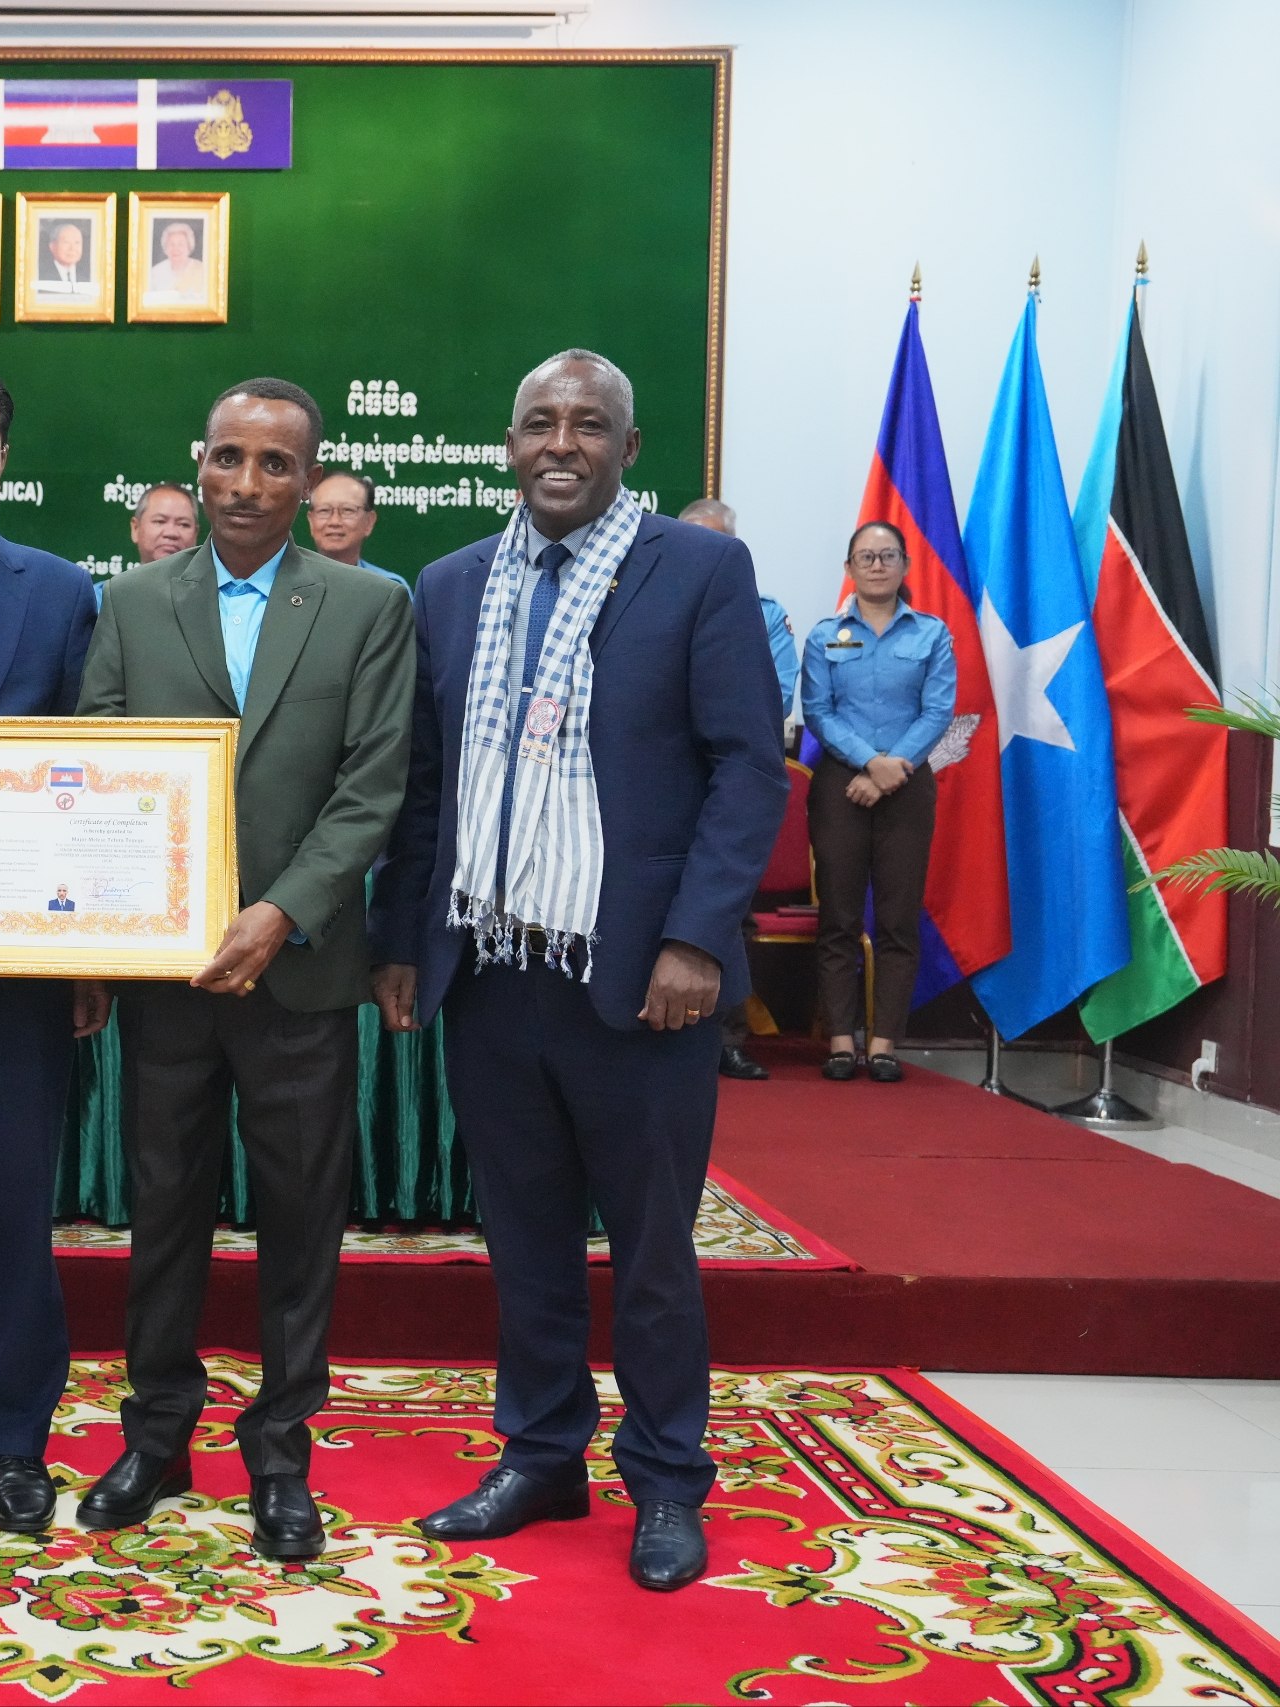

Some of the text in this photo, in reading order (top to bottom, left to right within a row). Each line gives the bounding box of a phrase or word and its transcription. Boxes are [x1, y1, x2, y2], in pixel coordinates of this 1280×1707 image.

[347, 379, 418, 417] ពិធីបិទ
[69, 817, 148, 827] Certificate of Completion
